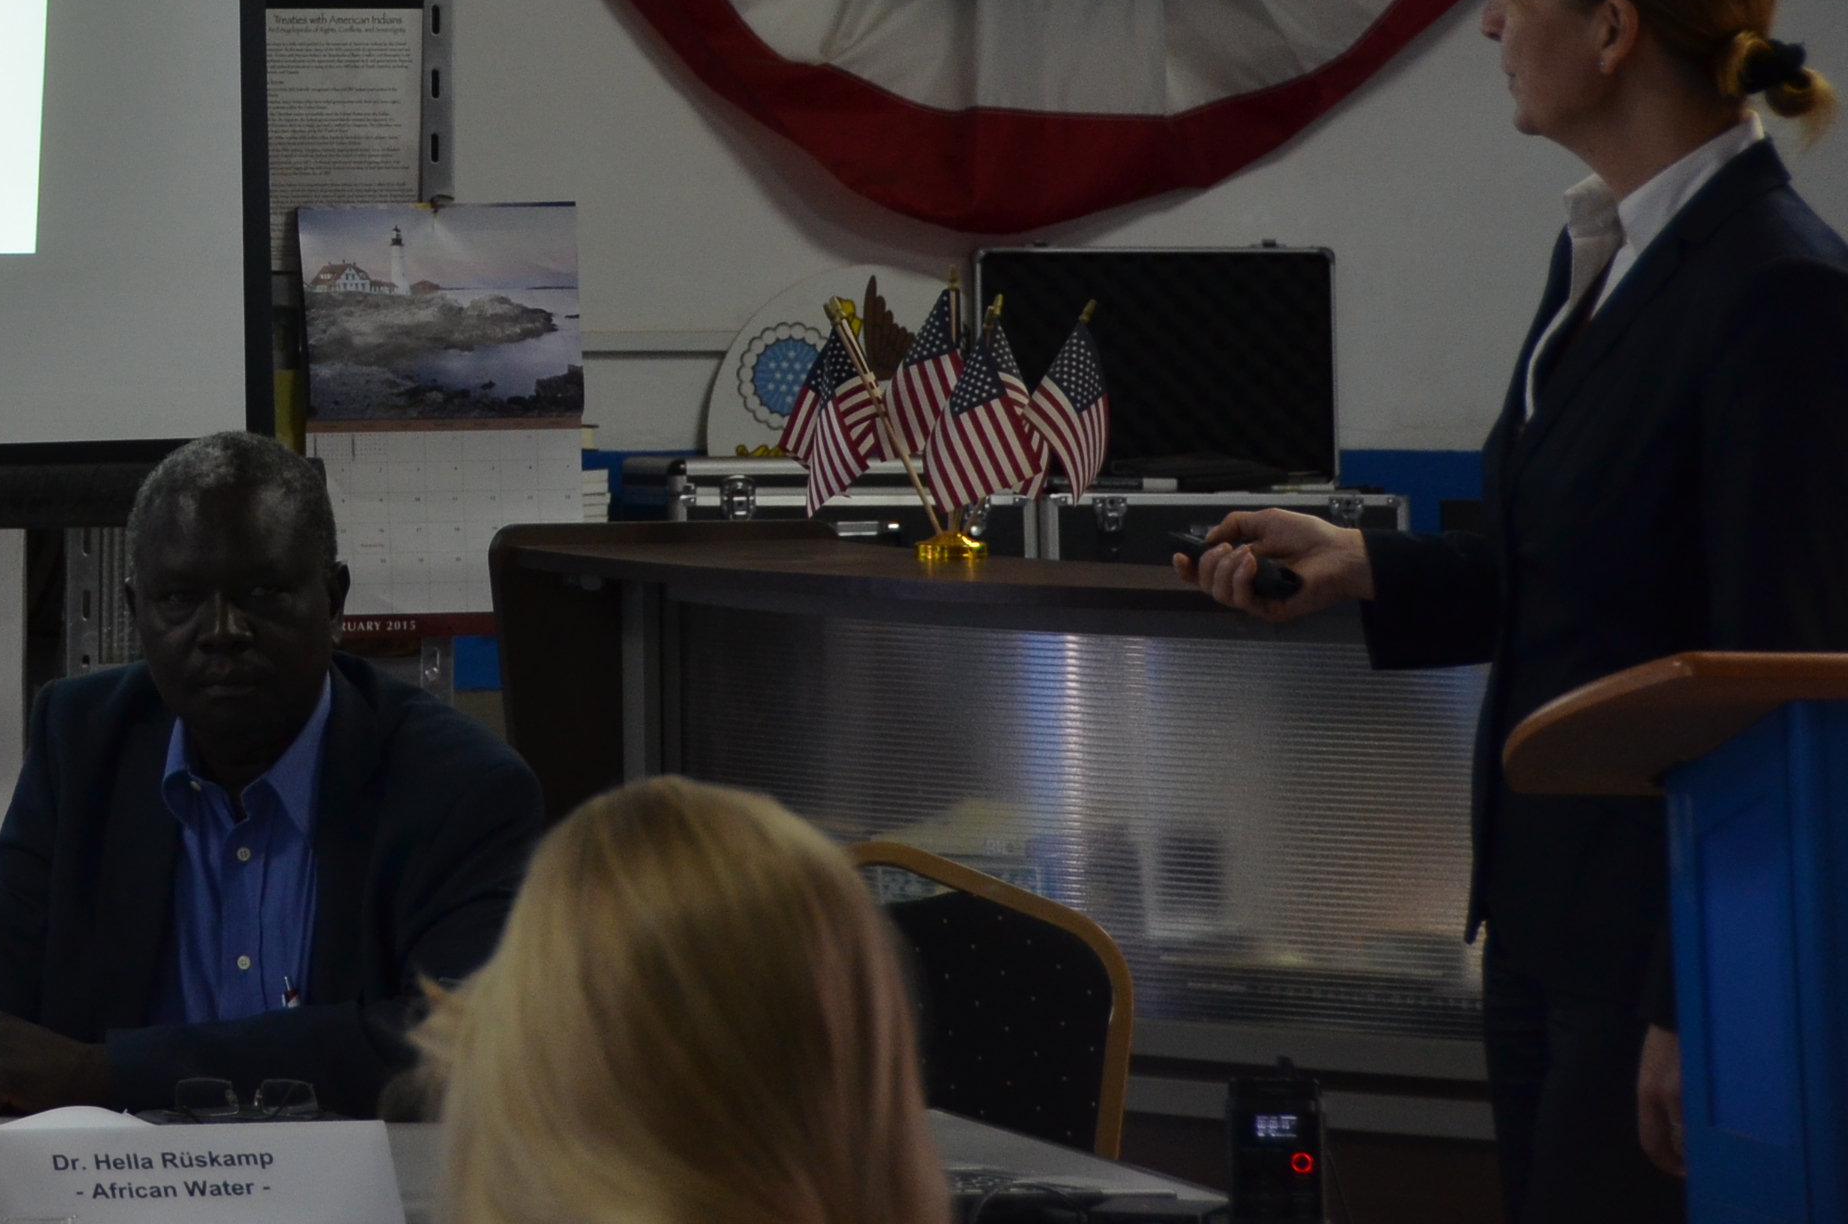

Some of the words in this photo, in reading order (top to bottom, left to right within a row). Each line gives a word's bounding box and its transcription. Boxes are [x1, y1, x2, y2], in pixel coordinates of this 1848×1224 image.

[273, 14, 308, 25] Treaties
[310, 12, 328, 25] with
[330, 14, 370, 25] American
[372, 12, 403, 25] Indians
[341, 620, 382, 632] RUARY
[386, 619, 417, 631] 2015
[52, 1154, 87, 1172] Dr.
[93, 1153, 154, 1171] Hella
[160, 1150, 274, 1170] Rüskamp
[92, 1182, 178, 1200] African
[183, 1180, 255, 1197] Water
